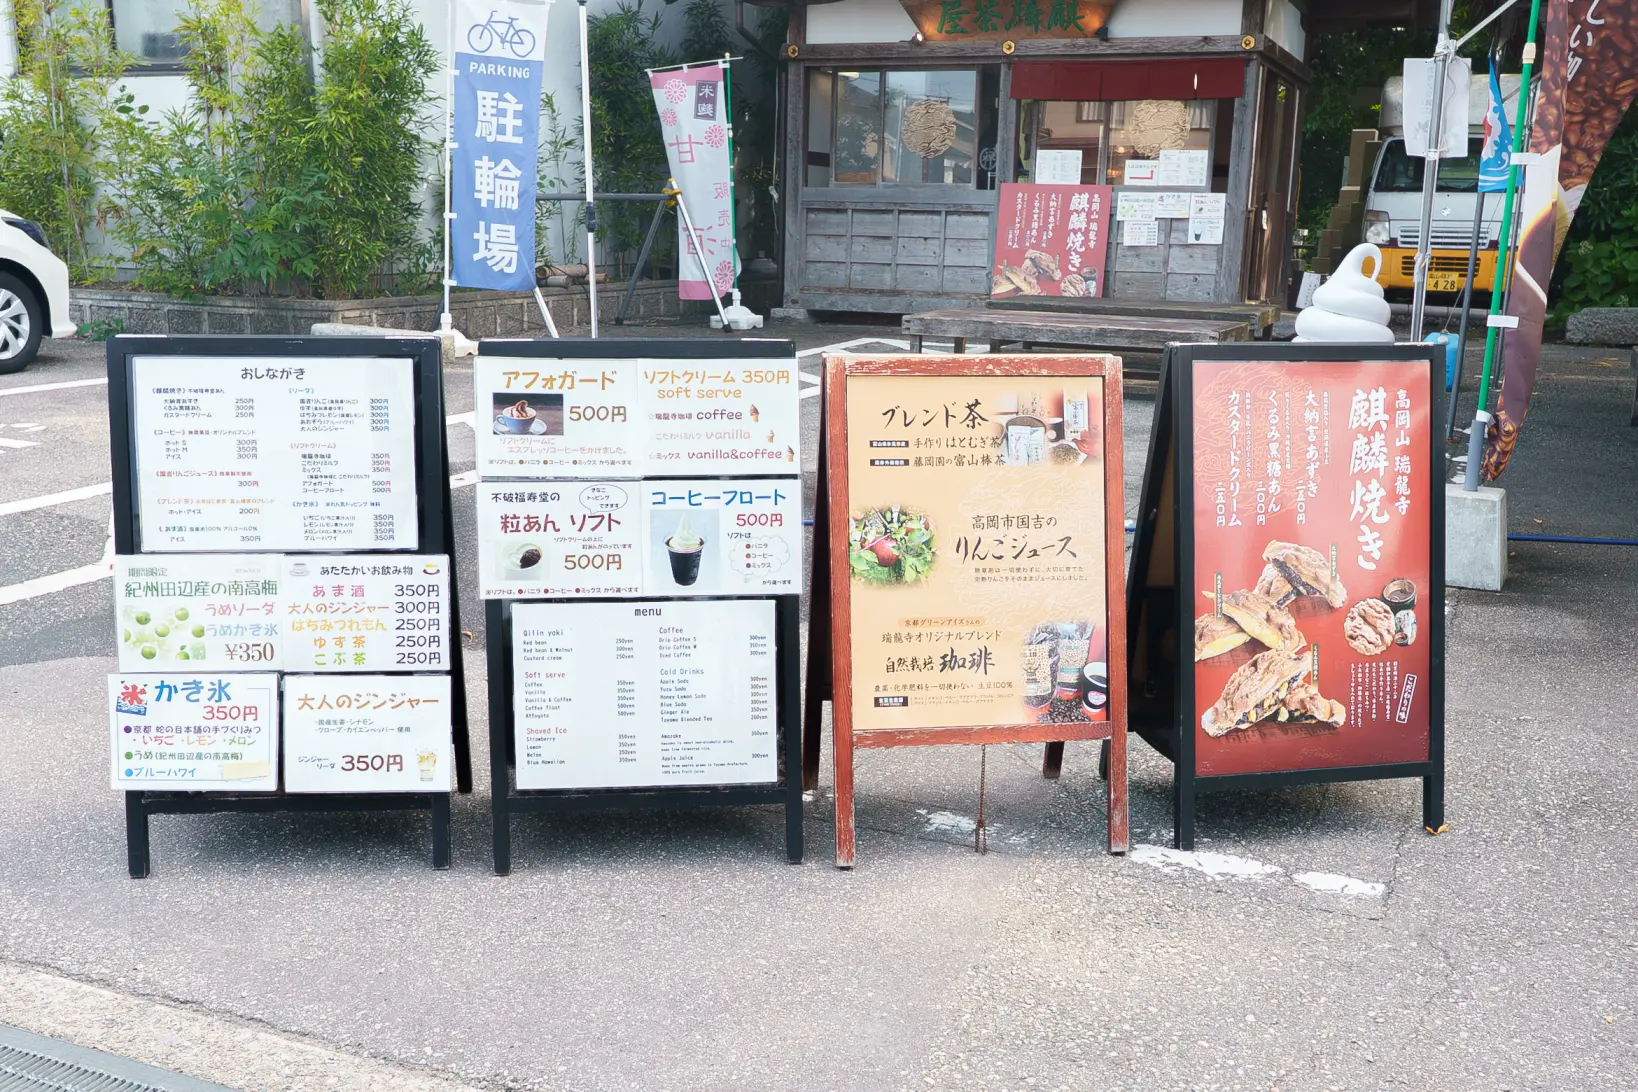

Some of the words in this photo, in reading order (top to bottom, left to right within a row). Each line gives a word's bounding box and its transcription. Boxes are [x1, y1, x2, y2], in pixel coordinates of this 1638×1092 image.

[469, 62, 530, 79] PARKING
[473, 90, 524, 274] 駐輪場
[1013, 192, 1023, 248] カスタードクリーム
[1066, 192, 1089, 272] 麒麟焼き
[241, 367, 305, 380] おしながき
[502, 370, 617, 391] アフォガード
[644, 370, 736, 385] ソフトクリーム
[742, 370, 790, 384] 350円
[657, 387, 691, 399] soft
[697, 388, 742, 399] serve
[569, 406, 627, 423] 500円
[696, 409, 743, 420] coffee
[882, 399, 990, 430] ブレンド茶
[1395, 389, 1411, 447] 高岡山
[705, 429, 751, 440] vanilla
[914, 437, 1002, 449] 手作りはとむぎ茶
[1304, 391, 1320, 498] 大納言あずき
[688, 449, 782, 460] vanilla&coffee
[1227, 391, 1242, 527] カスタードクリーム
[1267, 390, 1281, 513] くるみ黒糖あん
[1349, 386, 1390, 571] 麒麟焼き
[1394, 455, 1411, 515] 瑞龍寺
[491, 492, 560, 503] 不破福寿堂の
[652, 489, 786, 506] コーヒーフロート
[500, 513, 560, 534] 粒あん
[570, 513, 621, 532] ソフト
[736, 513, 783, 527] 500円
[972, 515, 1057, 531] 高岡市国吉の
[956, 534, 1077, 564] りんごジュース
[564, 554, 622, 571] 500円
[128, 568, 167, 577] 期間限定
[320, 566, 413, 576] あたたかいお飲み物
[125, 580, 278, 598] 紀州田辺産の南高梅
[313, 585, 365, 598] あま酒
[394, 585, 440, 597] 350円
[205, 602, 276, 616] うめソーダ
[288, 602, 389, 614] 大人のジンジャー
[395, 601, 440, 614] 300円
[635, 608, 662, 616] menu
[206, 623, 278, 637] うめかき氷
[292, 620, 387, 632] はちみつれもん
[395, 619, 440, 631] 250円
[314, 636, 366, 649] ゆず茶
[396, 635, 441, 648] 250円
[882, 630, 1003, 644] 瑞龍寺オリジナルブレンド
[225, 642, 274, 662] ¥350
[396, 652, 441, 664] 250円
[886, 655, 935, 674] 自然栽培
[940, 645, 995, 676] 珈琲
[155, 679, 232, 703] かき氷
[297, 693, 439, 710] 大人のジンジャー
[203, 705, 258, 721] 350円
[133, 726, 152, 734] 京都
[142, 735, 174, 745] いちご
[187, 736, 216, 745] レモン
[229, 736, 257, 746] メロン
[341, 754, 403, 772] 350円
[134, 767, 197, 777] ブルーハワイ
